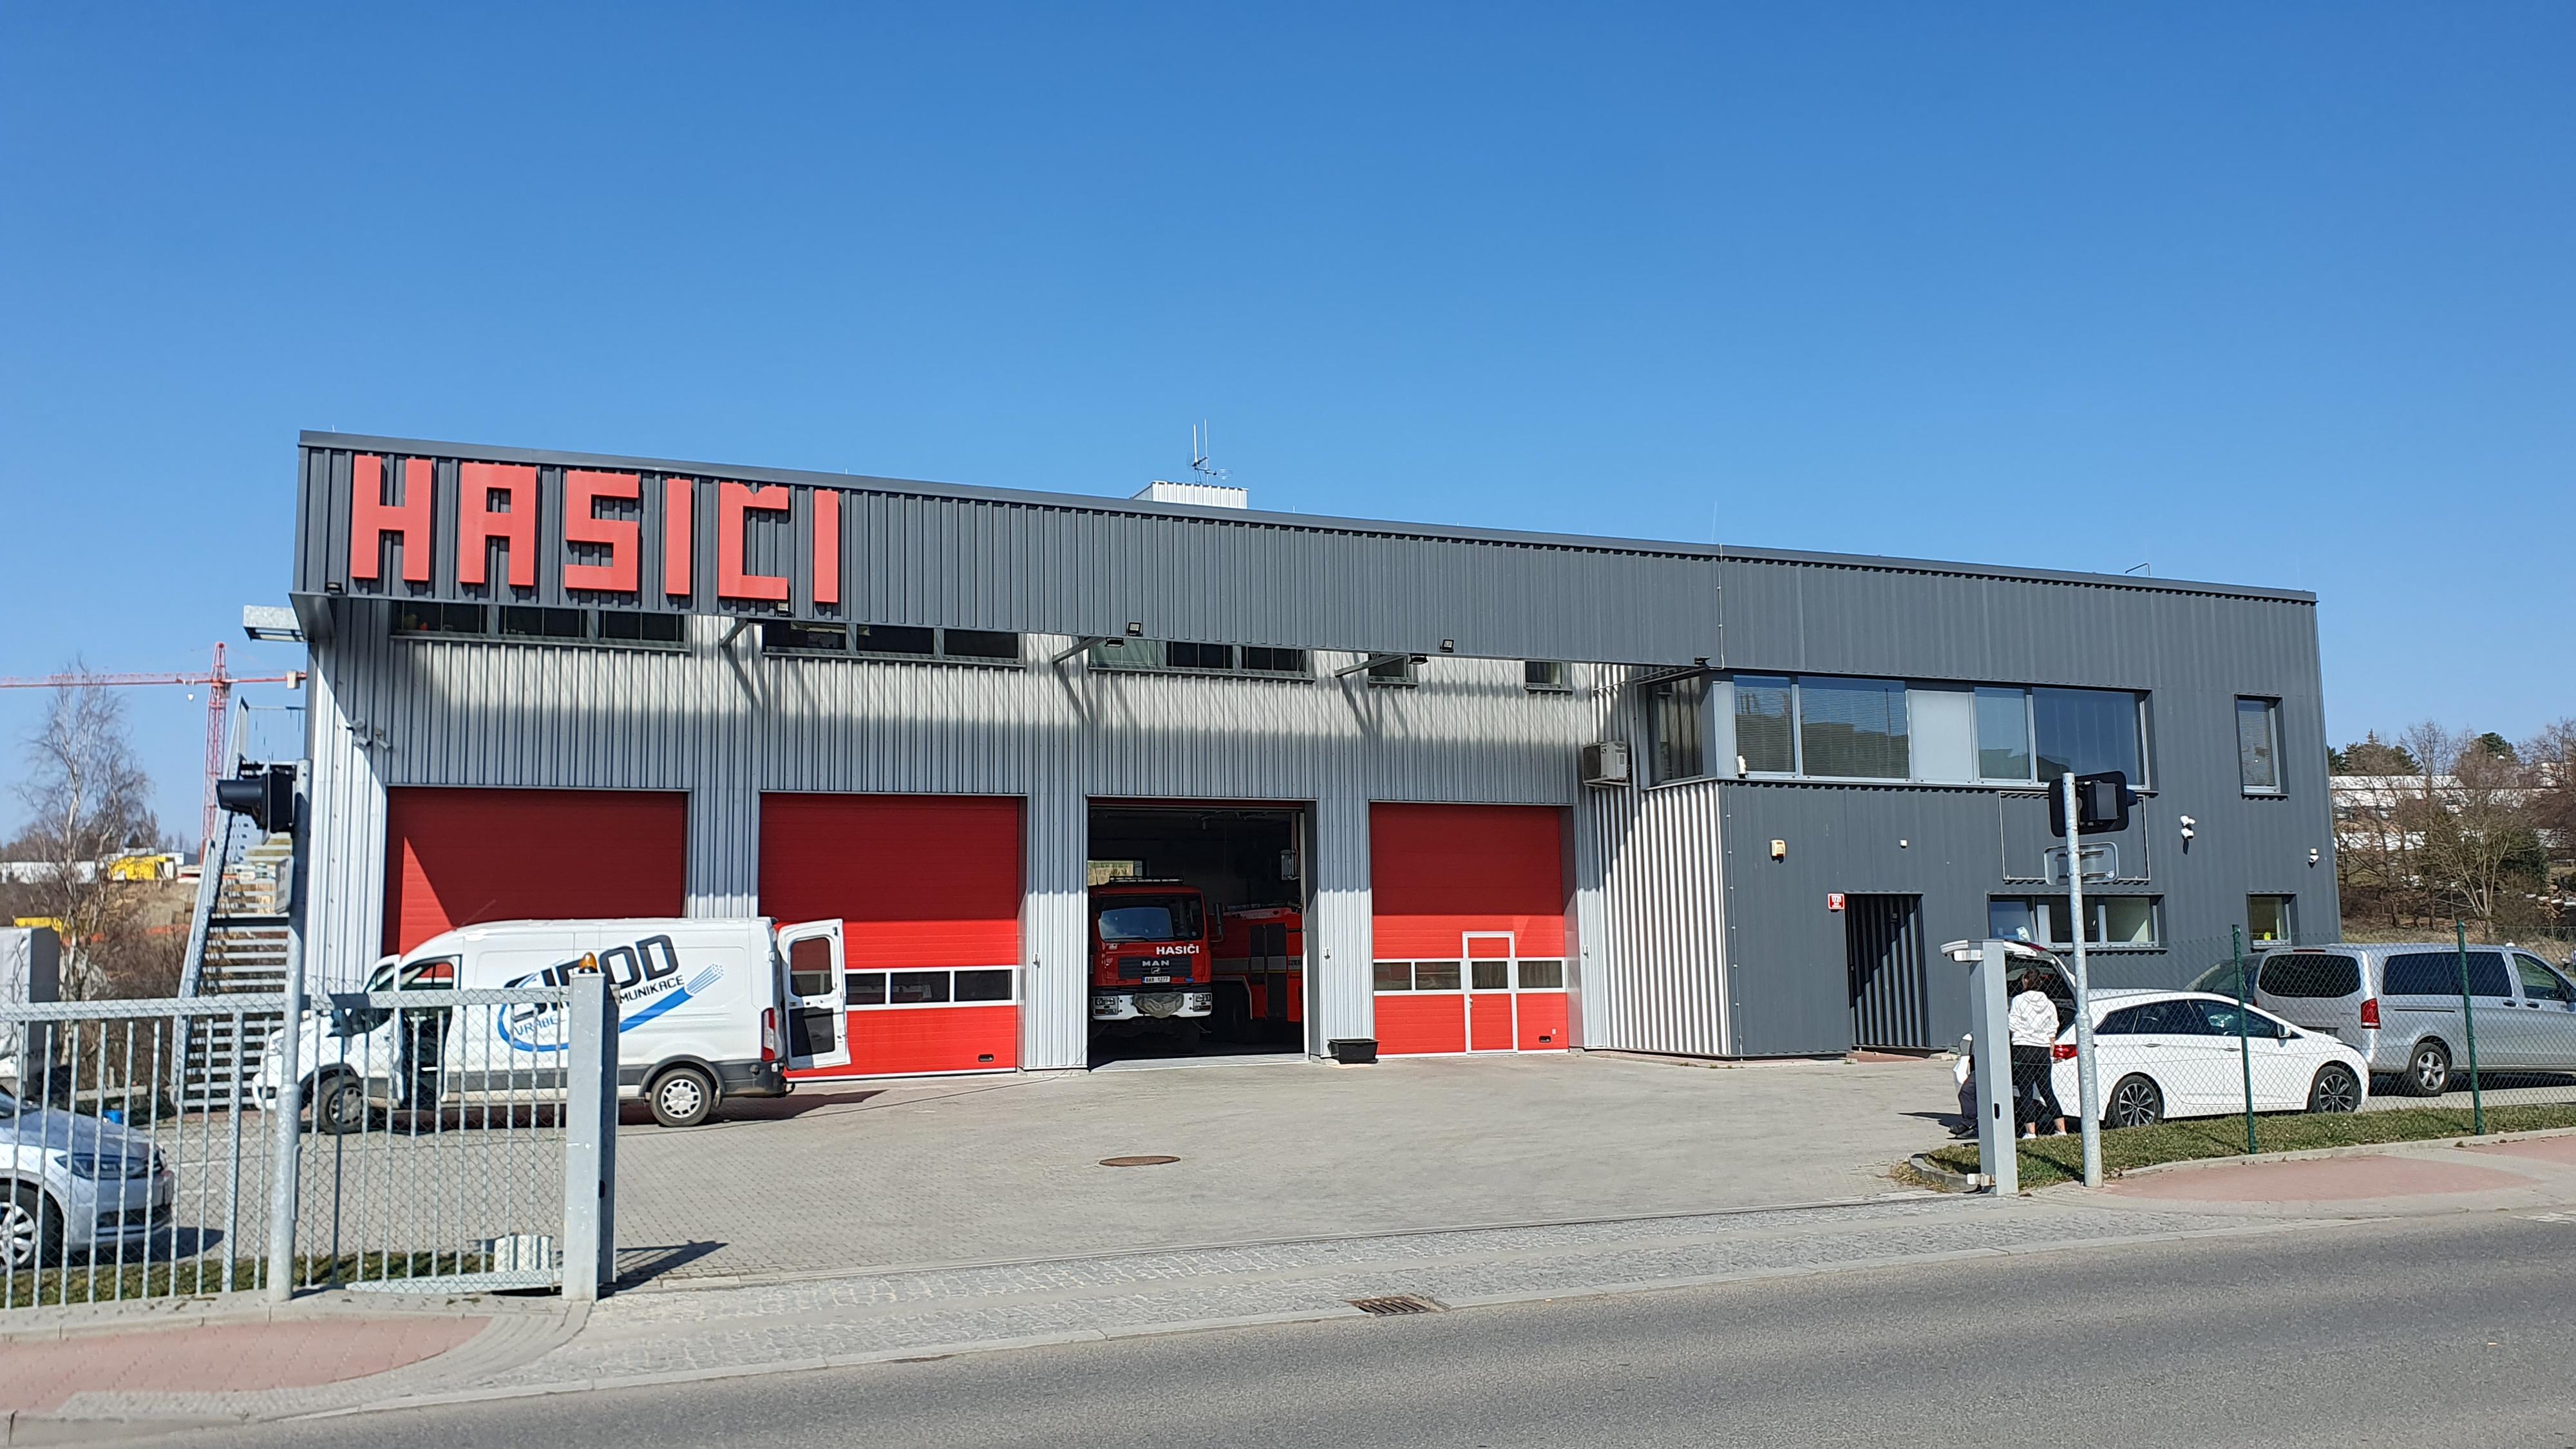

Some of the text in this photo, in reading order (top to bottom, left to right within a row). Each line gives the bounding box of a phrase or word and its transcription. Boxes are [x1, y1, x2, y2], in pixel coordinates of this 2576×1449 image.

[350, 453, 839, 604] HASIČI
[1156, 943, 1200, 955] HASIČI
[619, 974, 685, 1004] MUNIKACE
